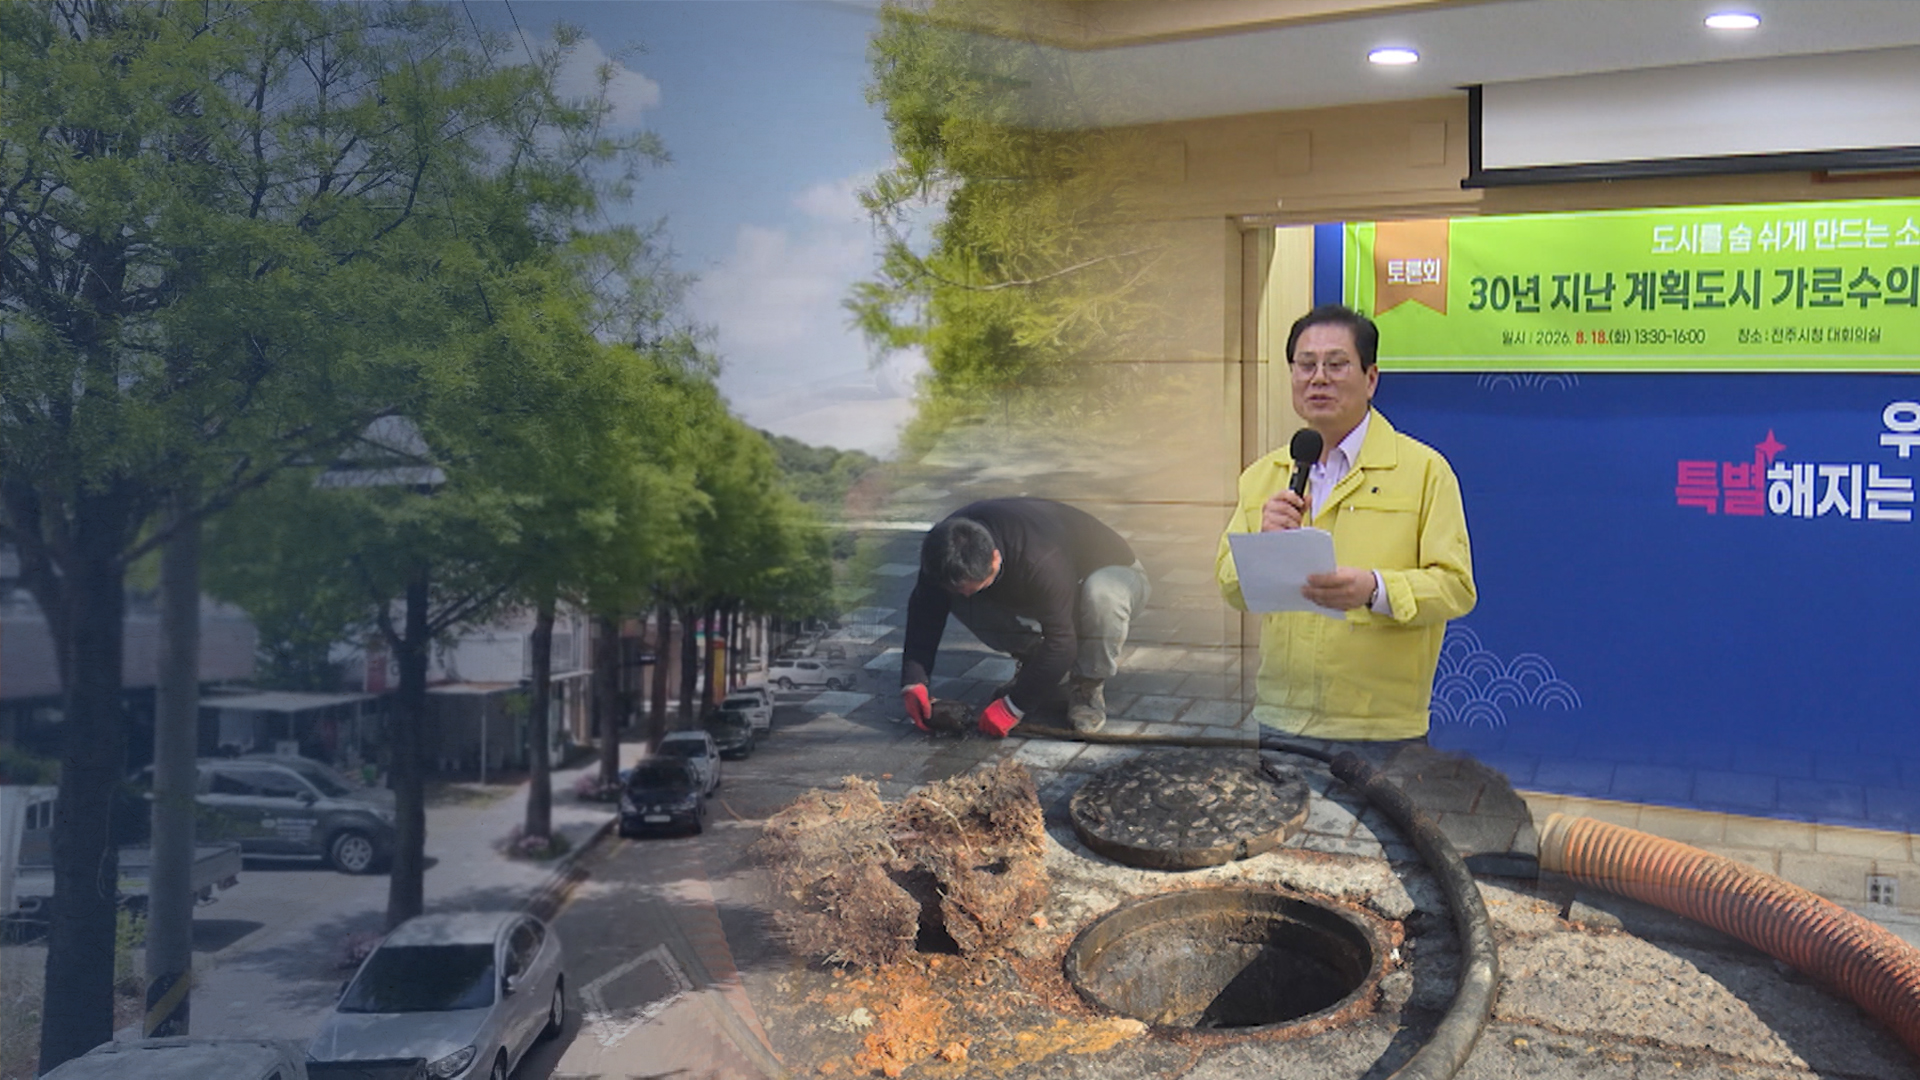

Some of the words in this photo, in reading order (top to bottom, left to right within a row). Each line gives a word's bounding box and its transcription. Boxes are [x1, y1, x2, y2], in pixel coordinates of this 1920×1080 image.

[1651, 222, 1723, 254] 도시를
[1728, 221, 1753, 253] 숨
[1758, 219, 1808, 252] 쉬게
[1814, 218, 1890, 250] 만드는
[1387, 258, 1441, 285] 토론회
[1468, 274, 1541, 313] 30년
[1550, 272, 1616, 313] 지난
[1623, 268, 1762, 312] 계획도시
[1772, 264, 1920, 310] 가로수의
[1827, 326, 1882, 343] 대회의실
[1675, 448, 1914, 521] 특별해지는
